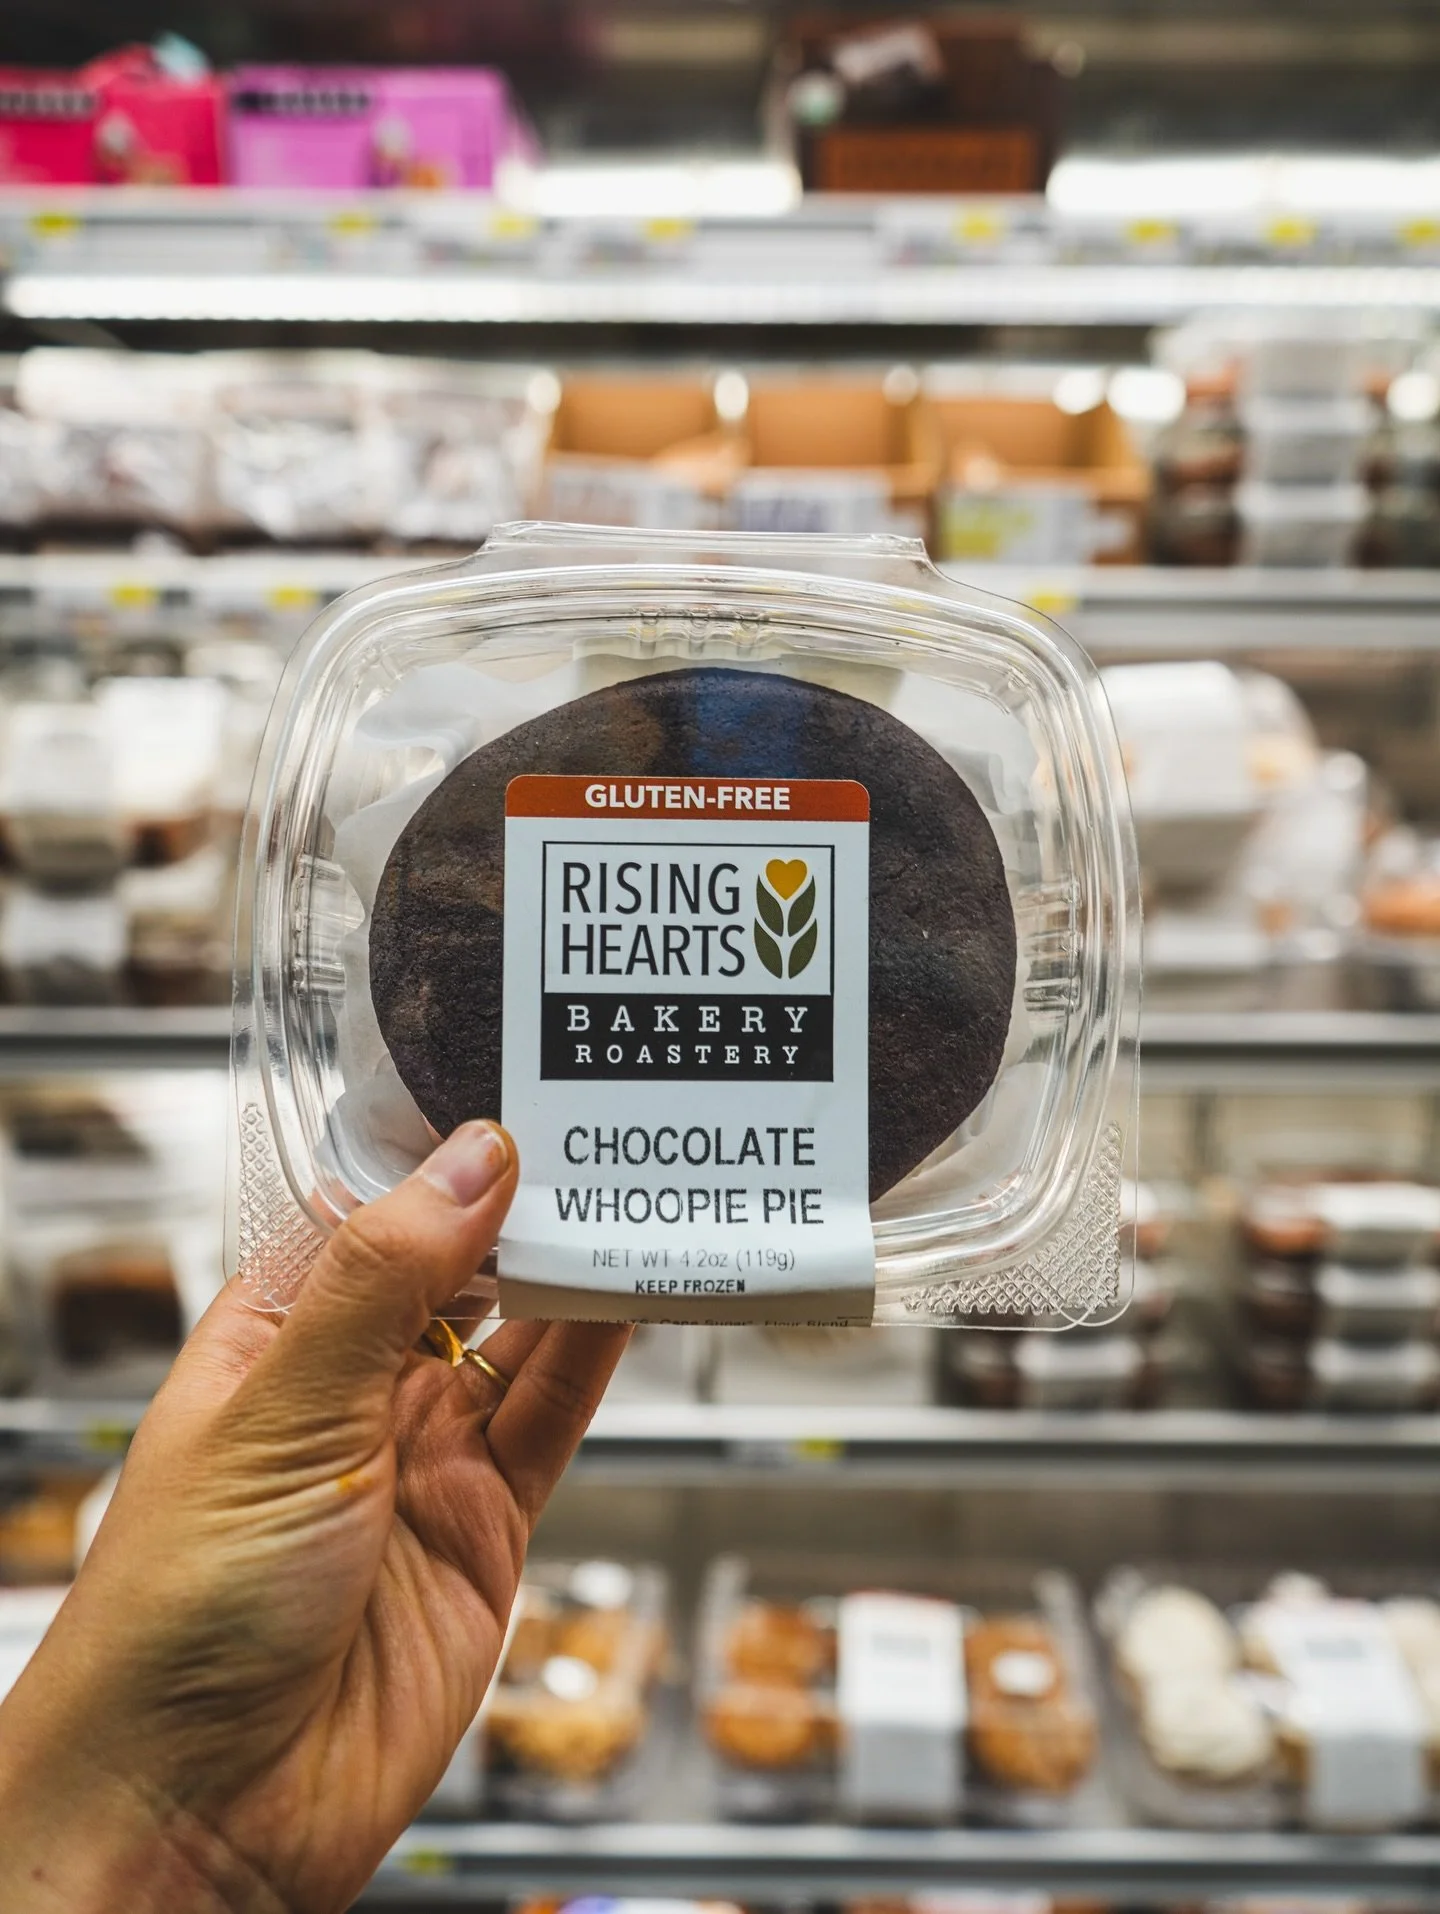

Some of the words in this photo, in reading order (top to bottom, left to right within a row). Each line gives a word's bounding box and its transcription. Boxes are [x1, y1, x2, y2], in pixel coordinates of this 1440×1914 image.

[585, 784, 791, 810] GLUTEN-FREE
[562, 861, 741, 915] RISING
[561, 923, 746, 977] HEARTS
[567, 1005, 809, 1033] BAKERY
[575, 1044, 800, 1064] ROASTERY
[564, 1125, 816, 1166] CHOCOLATE
[555, 1187, 749, 1224] WHOOPIE
[763, 1188, 825, 1225] PIE
[592, 1248, 632, 1267] NET
[641, 1248, 671, 1267] WT
[679, 1248, 728, 1268] 4.2oz
[736, 1248, 795, 1272] (119g)
[635, 1280, 678, 1294] KEEP
[683, 1279, 746, 1293] FROZEN
